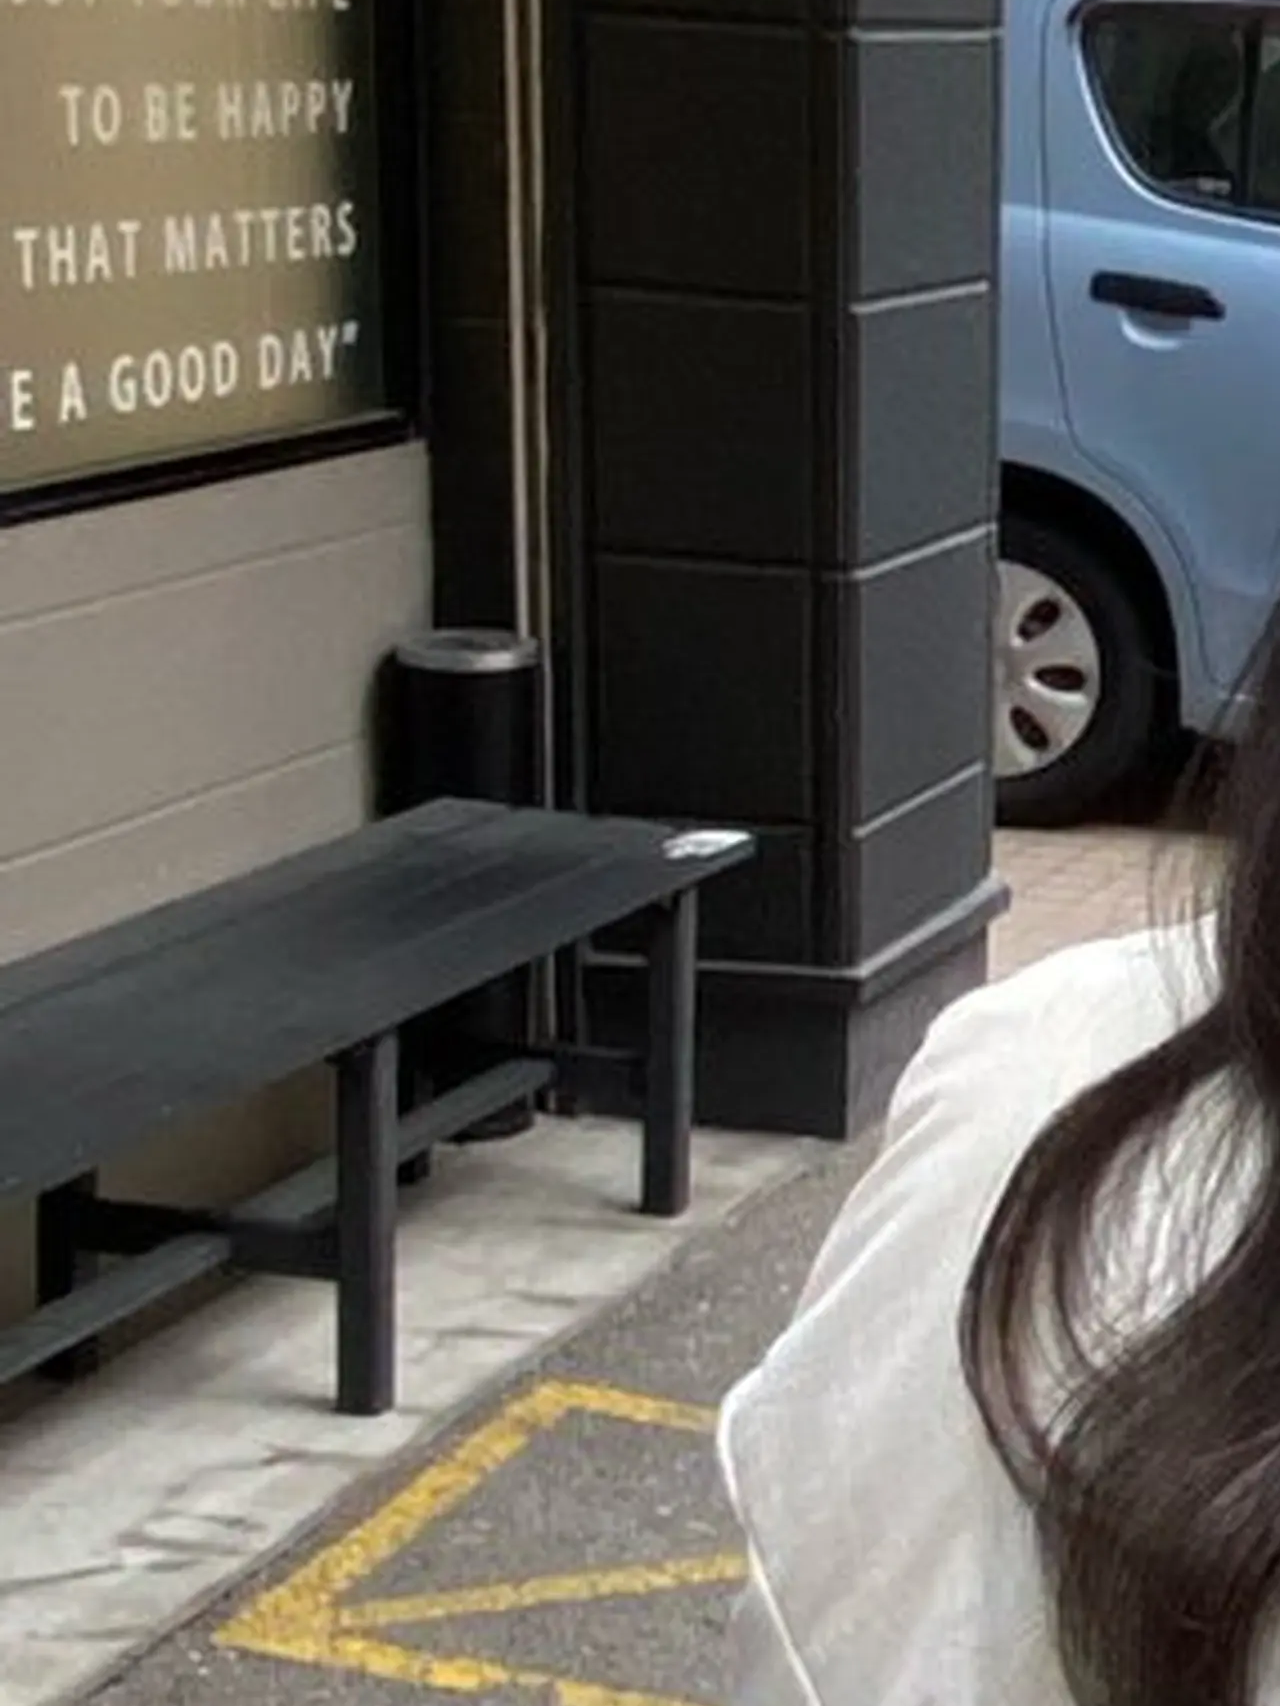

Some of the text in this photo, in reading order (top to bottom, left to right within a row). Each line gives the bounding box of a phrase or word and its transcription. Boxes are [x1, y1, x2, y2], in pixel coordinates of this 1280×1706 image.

[59, 78, 353, 145] TO BE HAPPY
[13, 201, 356, 289] THAT MATTERS
[59, 360, 87, 423] A
[107, 340, 240, 414] GOOD
